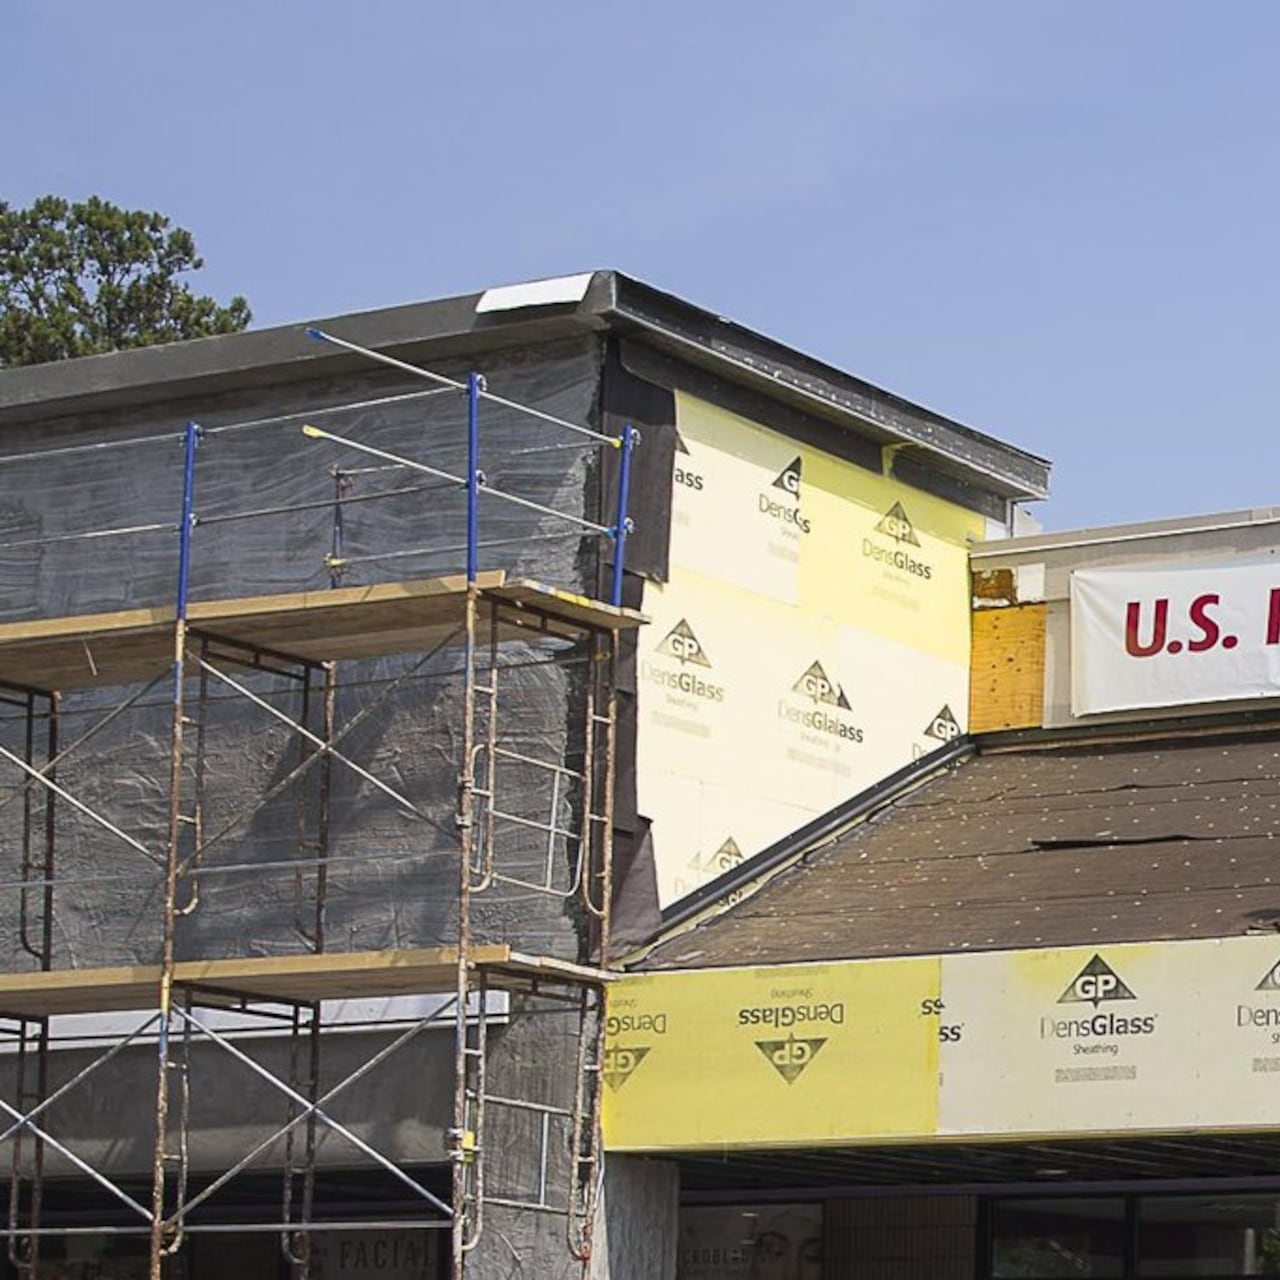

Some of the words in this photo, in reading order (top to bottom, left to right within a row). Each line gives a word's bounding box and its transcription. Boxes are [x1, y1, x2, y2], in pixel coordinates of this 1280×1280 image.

[862, 539, 932, 581] DensGlass
[1125, 594, 1239, 657] U.S.
[669, 633, 700, 661] GP
[641, 658, 724, 702] DensGlass
[1074, 974, 1117, 1000] GP
[738, 1002, 844, 1029] DensGlass
[1040, 1014, 1155, 1039] DensGlass
[771, 1041, 811, 1066] GP
[1073, 1043, 1119, 1056] Sheathing
